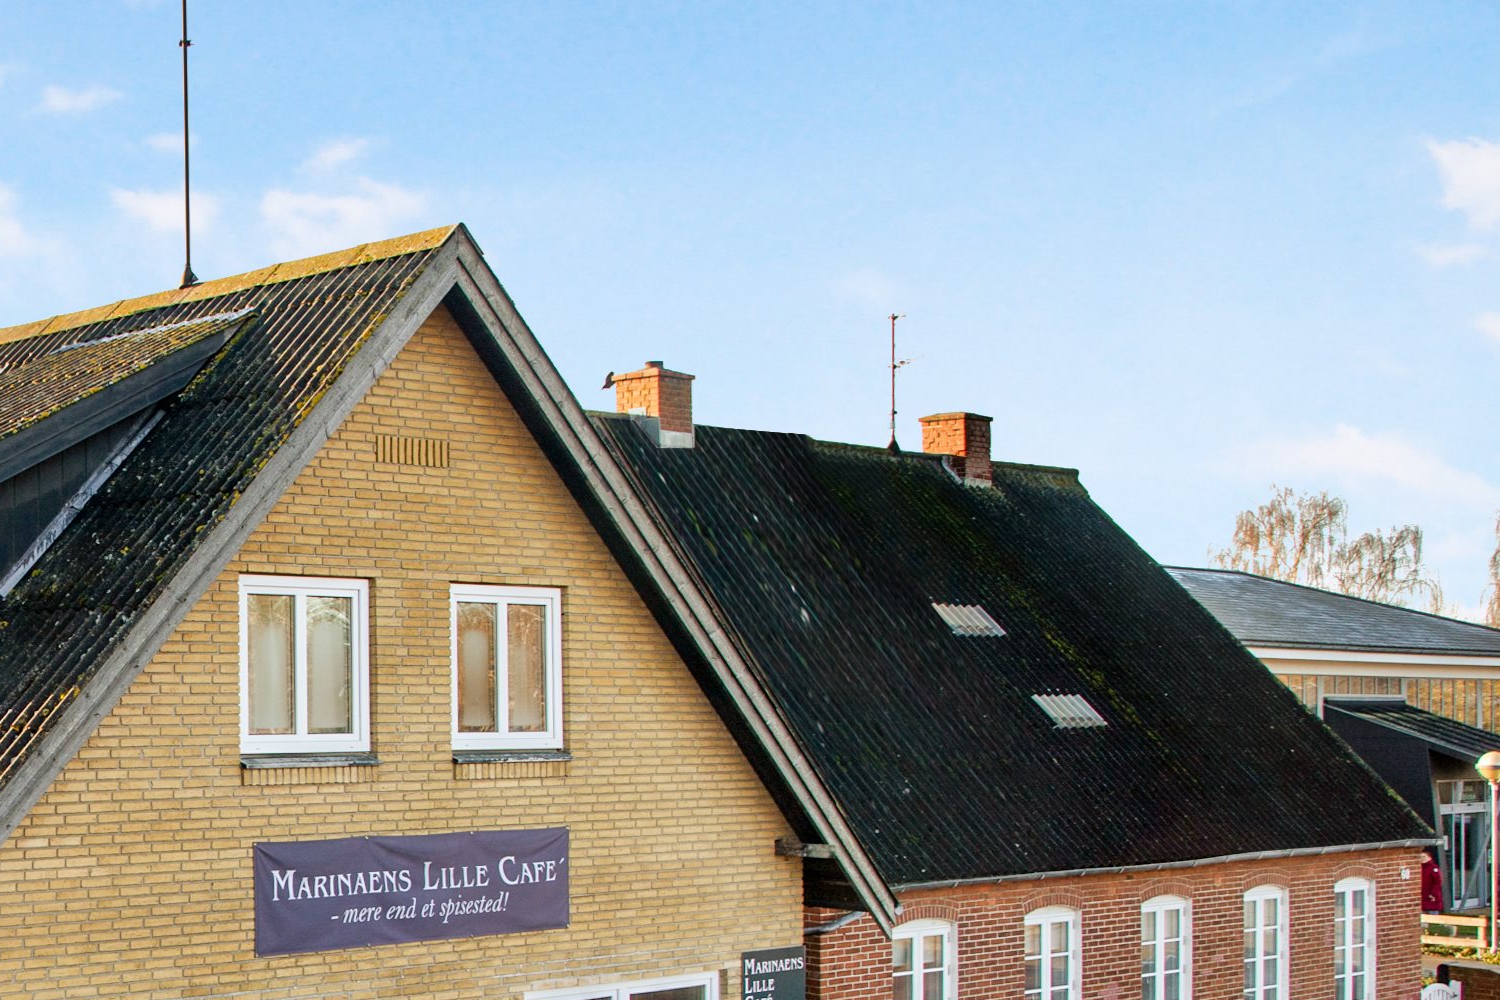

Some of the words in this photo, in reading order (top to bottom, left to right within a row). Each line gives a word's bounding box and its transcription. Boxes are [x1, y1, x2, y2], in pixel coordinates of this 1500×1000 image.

[271, 869, 412, 902] MARINAENS
[423, 860, 490, 891] LILLE
[343, 903, 382, 924] mere
[386, 898, 417, 920] end
[421, 898, 435, 918] et
[439, 892, 509, 924] spisested!
[745, 957, 804, 975] MARINAENS
[745, 978, 775, 994] LILLE
